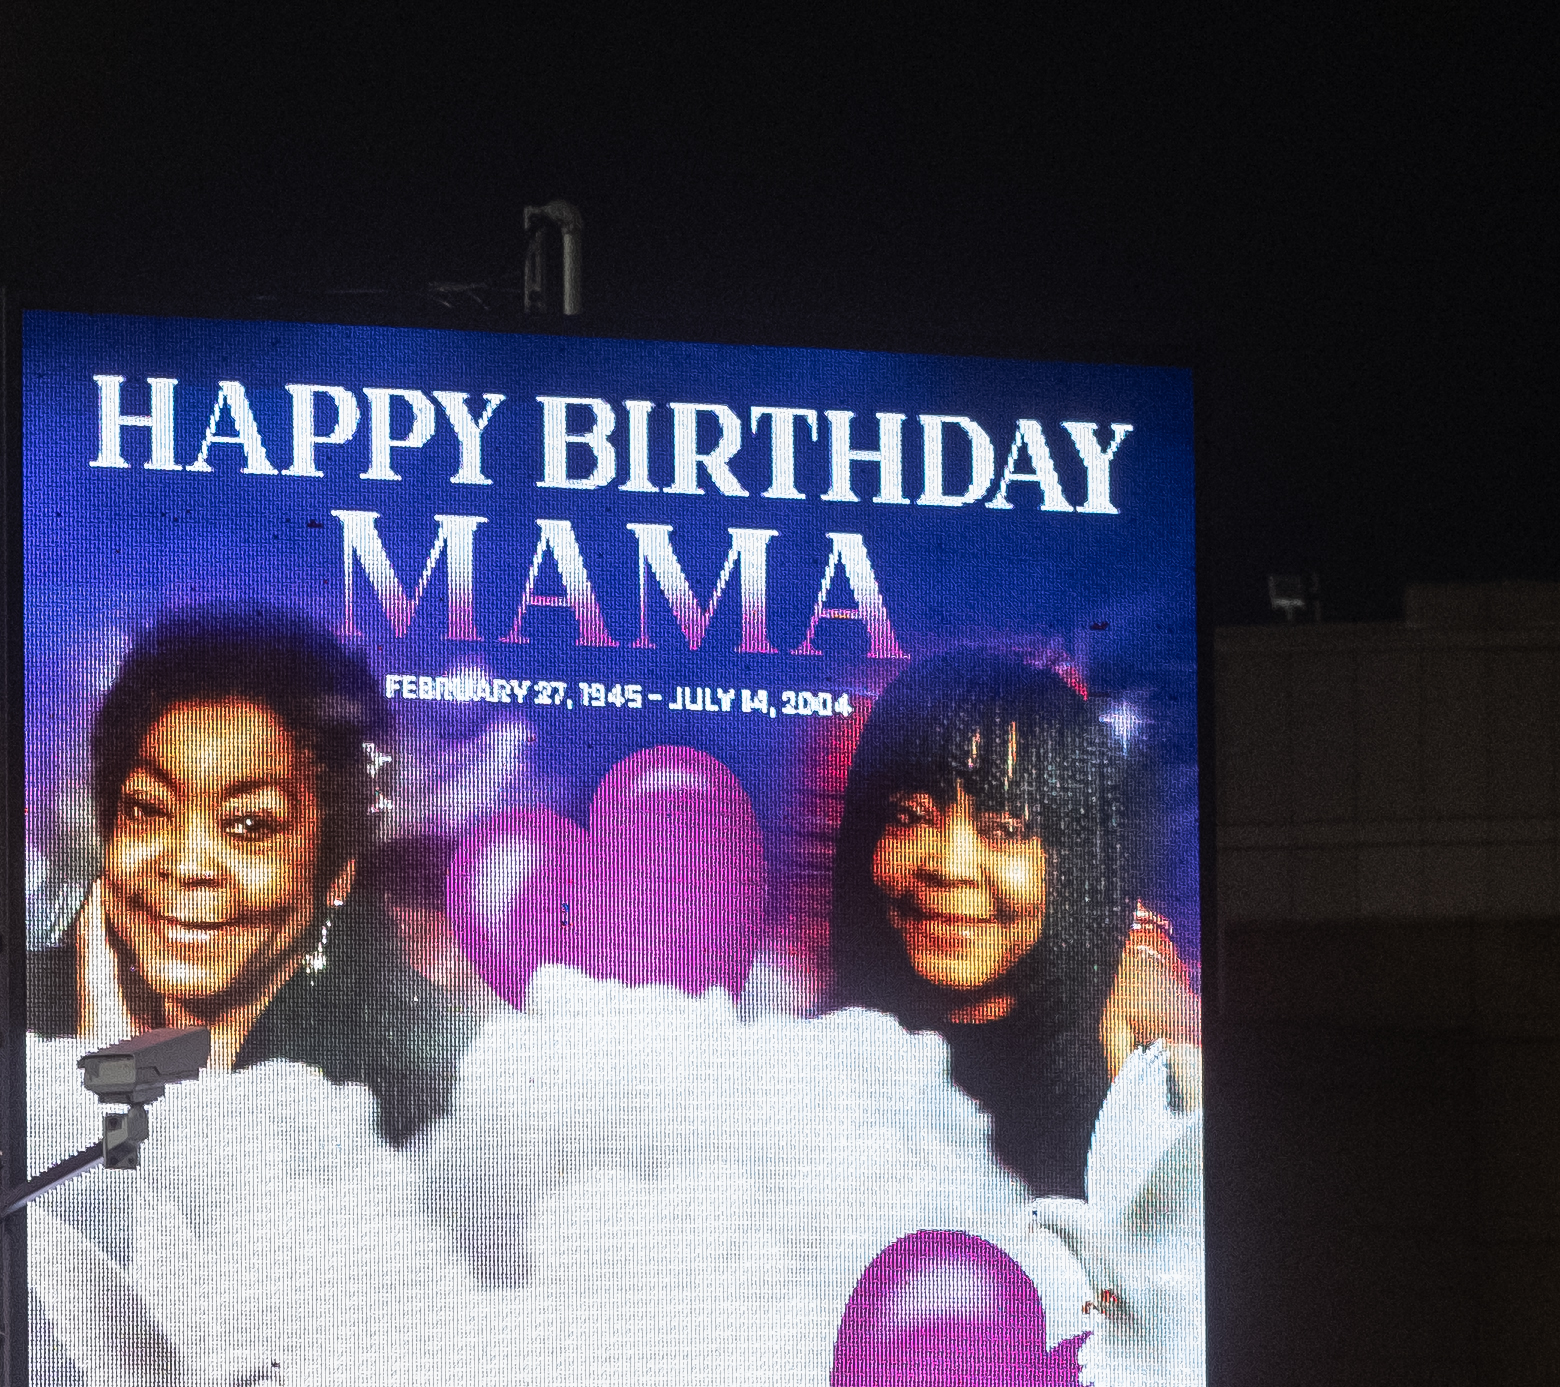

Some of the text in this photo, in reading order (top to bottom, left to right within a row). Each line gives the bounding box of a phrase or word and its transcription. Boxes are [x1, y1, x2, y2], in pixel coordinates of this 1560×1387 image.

[88, 374, 1135, 514] HAPPY BIRTHDAY
[331, 509, 911, 660] MAMA
[384, 673, 532, 704] FEBRUARY
[534, 680, 573, 709] 27,
[578, 682, 642, 709] 1945
[668, 686, 736, 712] JULY
[741, 690, 776, 718] 14,
[781, 691, 854, 717] 2004
